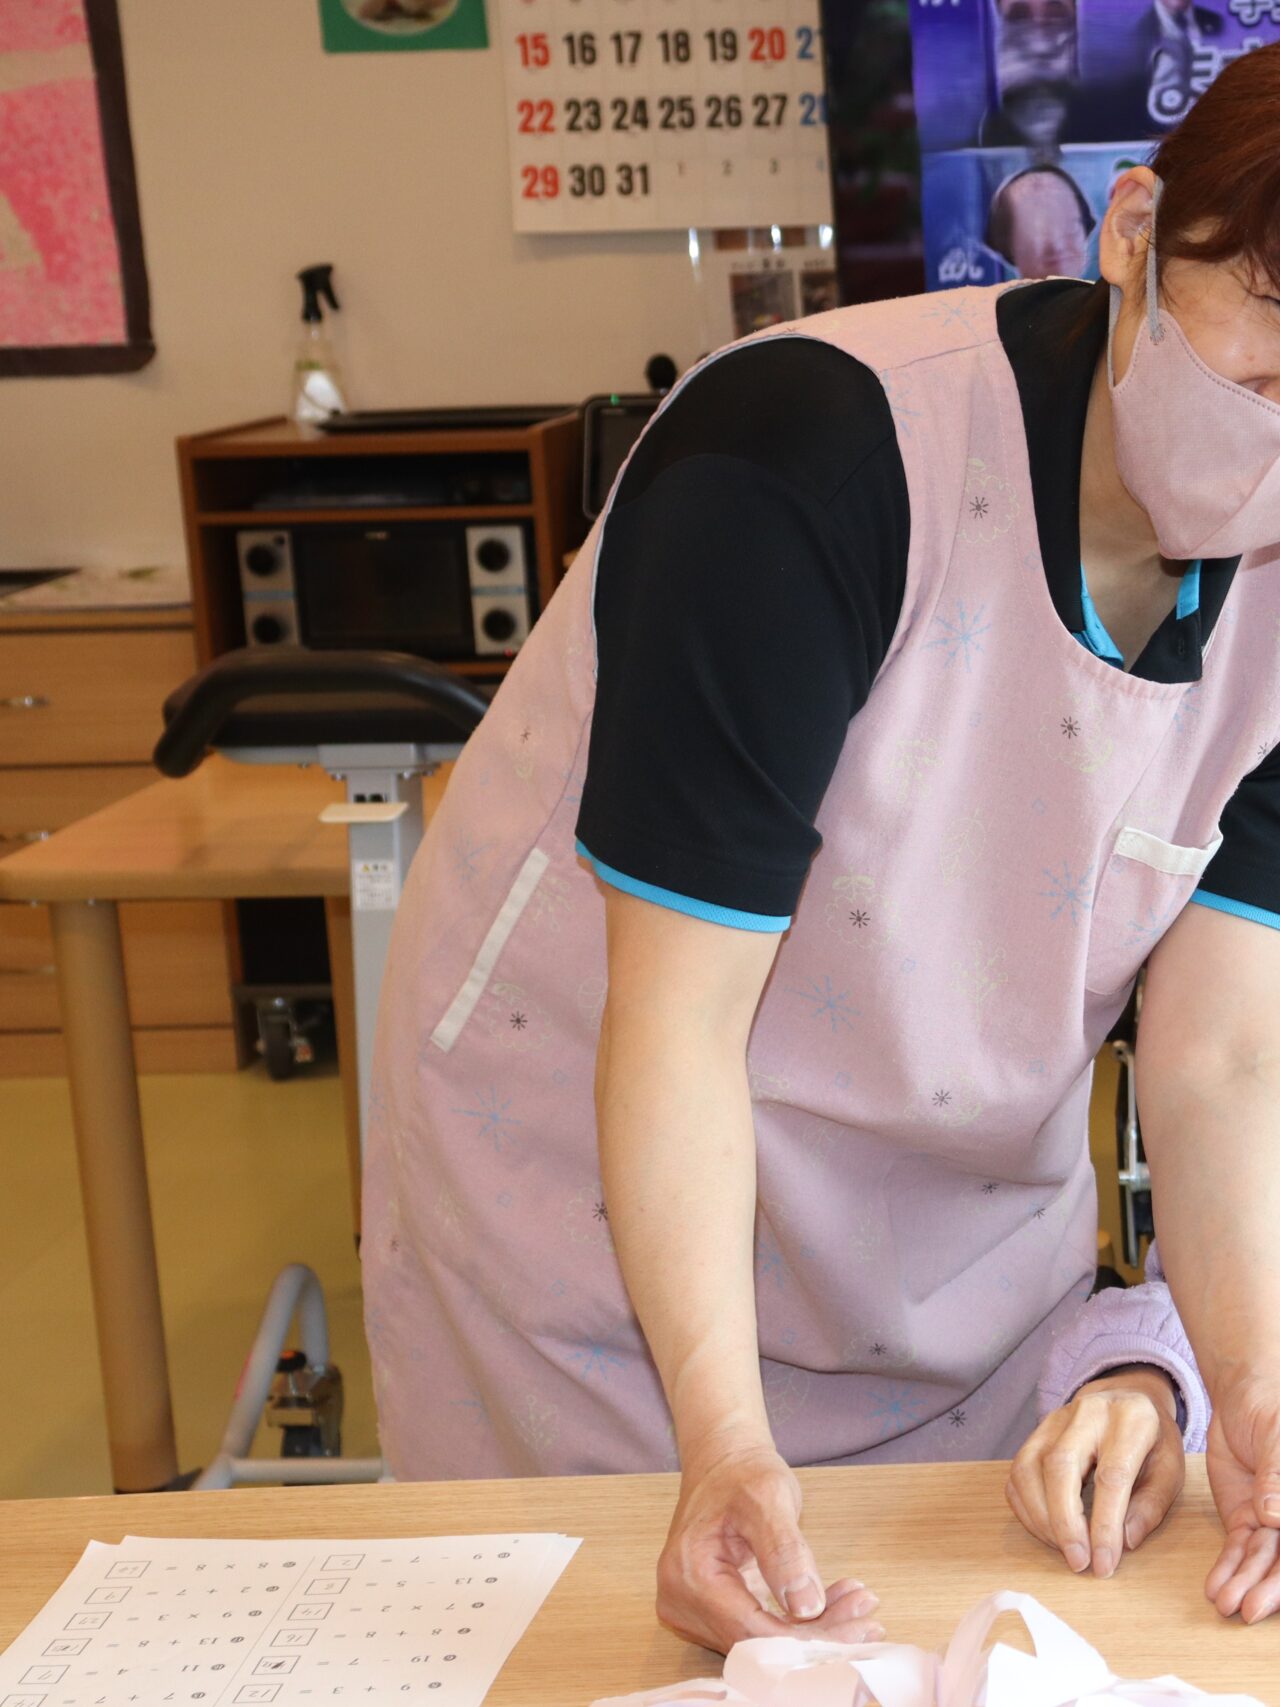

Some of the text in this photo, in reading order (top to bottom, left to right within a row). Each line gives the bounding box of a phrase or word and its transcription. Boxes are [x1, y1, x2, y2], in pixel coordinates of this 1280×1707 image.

[516, 25, 821, 68] 15 16 17 18 19 20 2
[518, 99, 555, 133] 22
[564, 98, 602, 132] 23
[611, 96, 649, 131] 24
[658, 95, 695, 130] 25
[705, 94, 742, 128] 26
[752, 93, 789, 127] 27
[521, 165, 560, 199] 29
[568, 164, 606, 198] 30
[616, 163, 649, 197] 31
